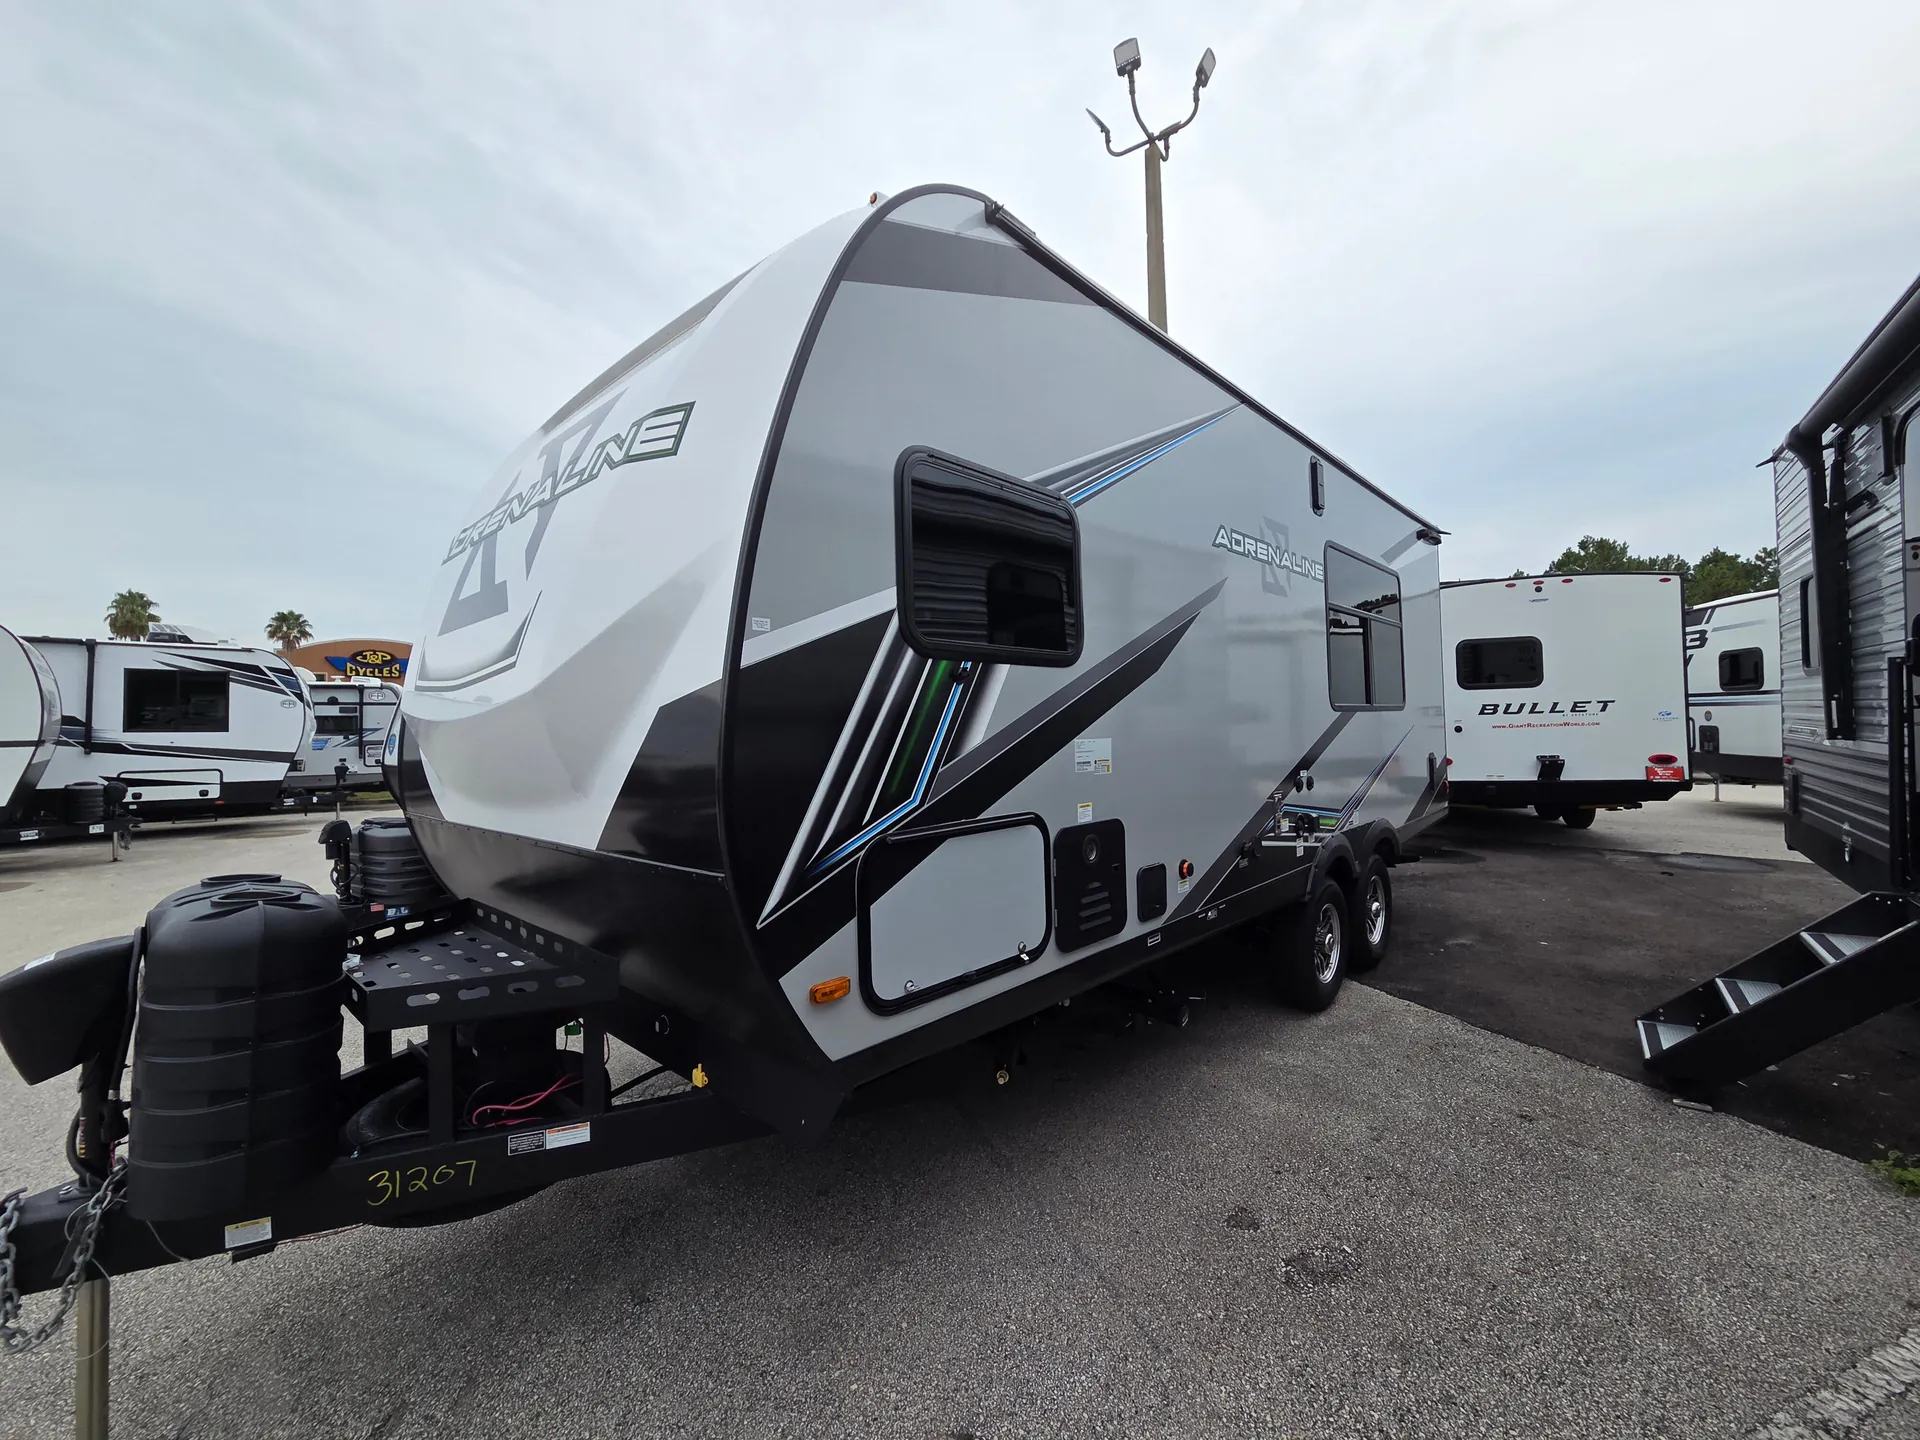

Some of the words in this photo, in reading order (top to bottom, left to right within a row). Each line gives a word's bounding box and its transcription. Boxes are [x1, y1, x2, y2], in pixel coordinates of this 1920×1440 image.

[441, 401, 696, 566] DRENALINE
[1212, 524, 1324, 583] ADRENALINE
[356, 651, 391, 664] J&P
[346, 662, 400, 677] CYCLES
[1478, 700, 1616, 715] BULLET
